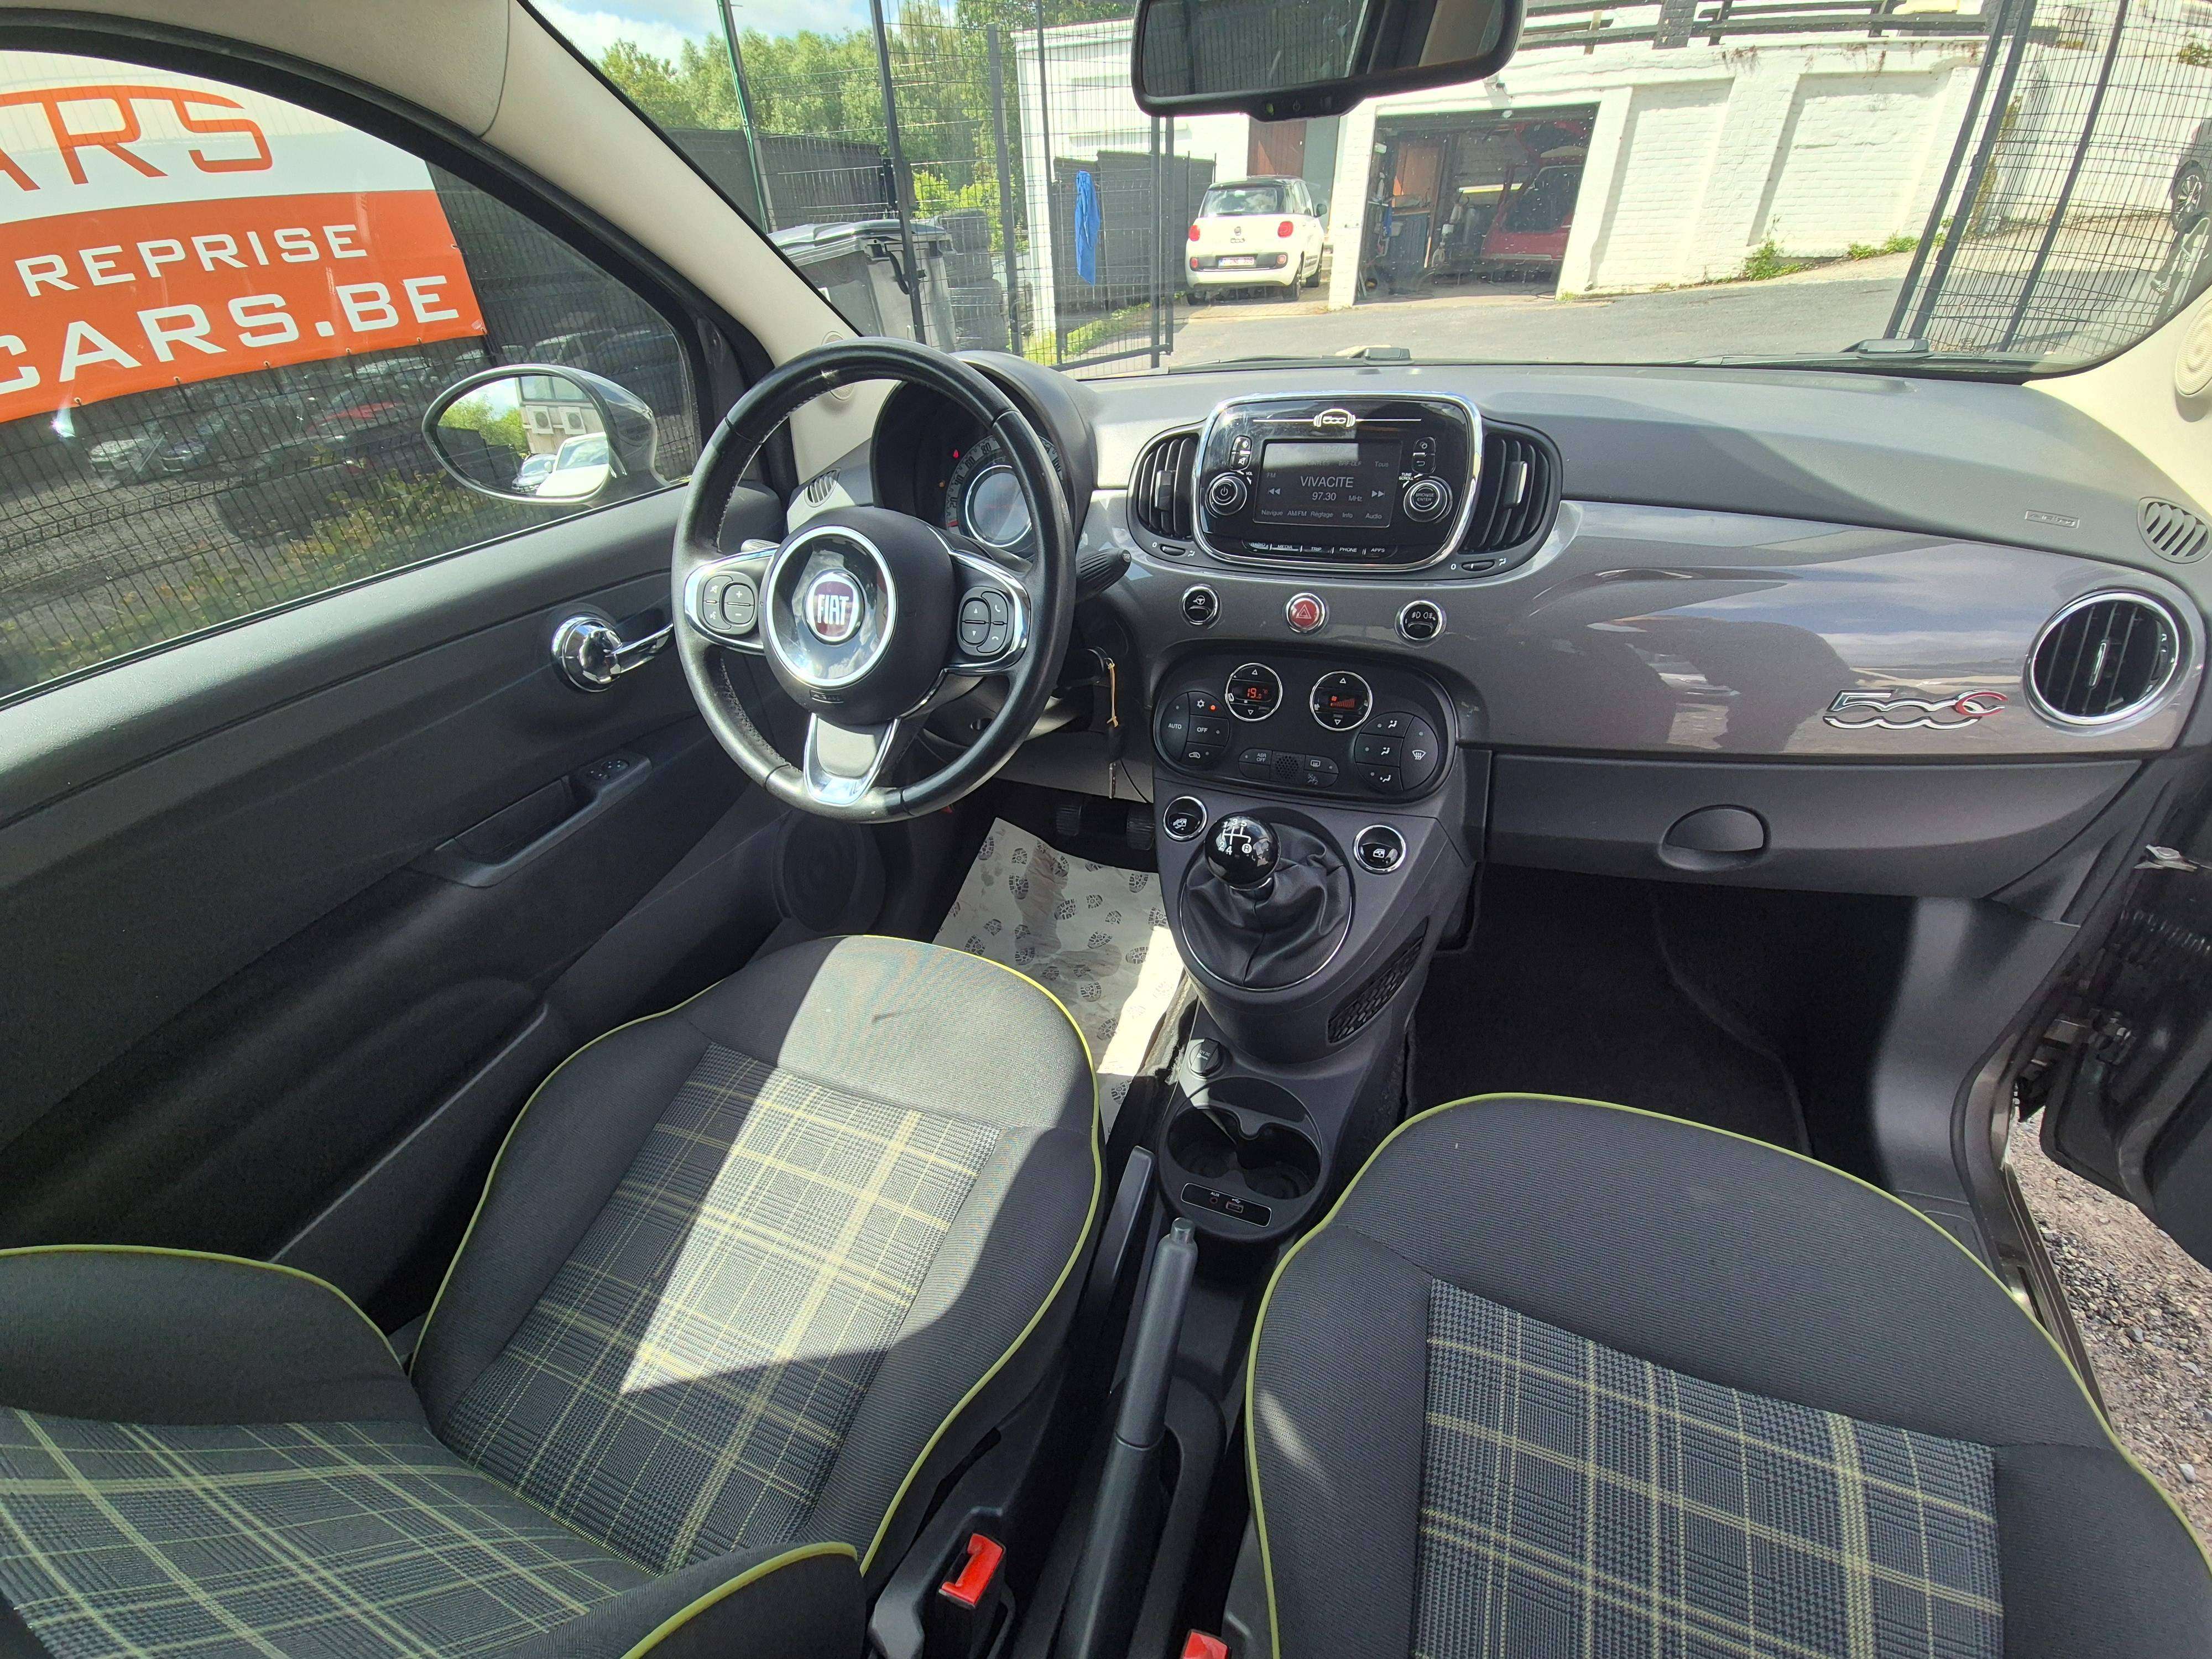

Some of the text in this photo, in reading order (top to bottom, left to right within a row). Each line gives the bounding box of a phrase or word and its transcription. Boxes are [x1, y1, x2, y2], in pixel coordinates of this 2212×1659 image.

[14, 224, 368, 297] REPRISE
[1300, 476, 1354, 488] VIVACITE
[1312, 492, 1337, 500] 97.30
[817, 594, 850, 625] FIAT
[1226, 846, 1232, 855] 4
